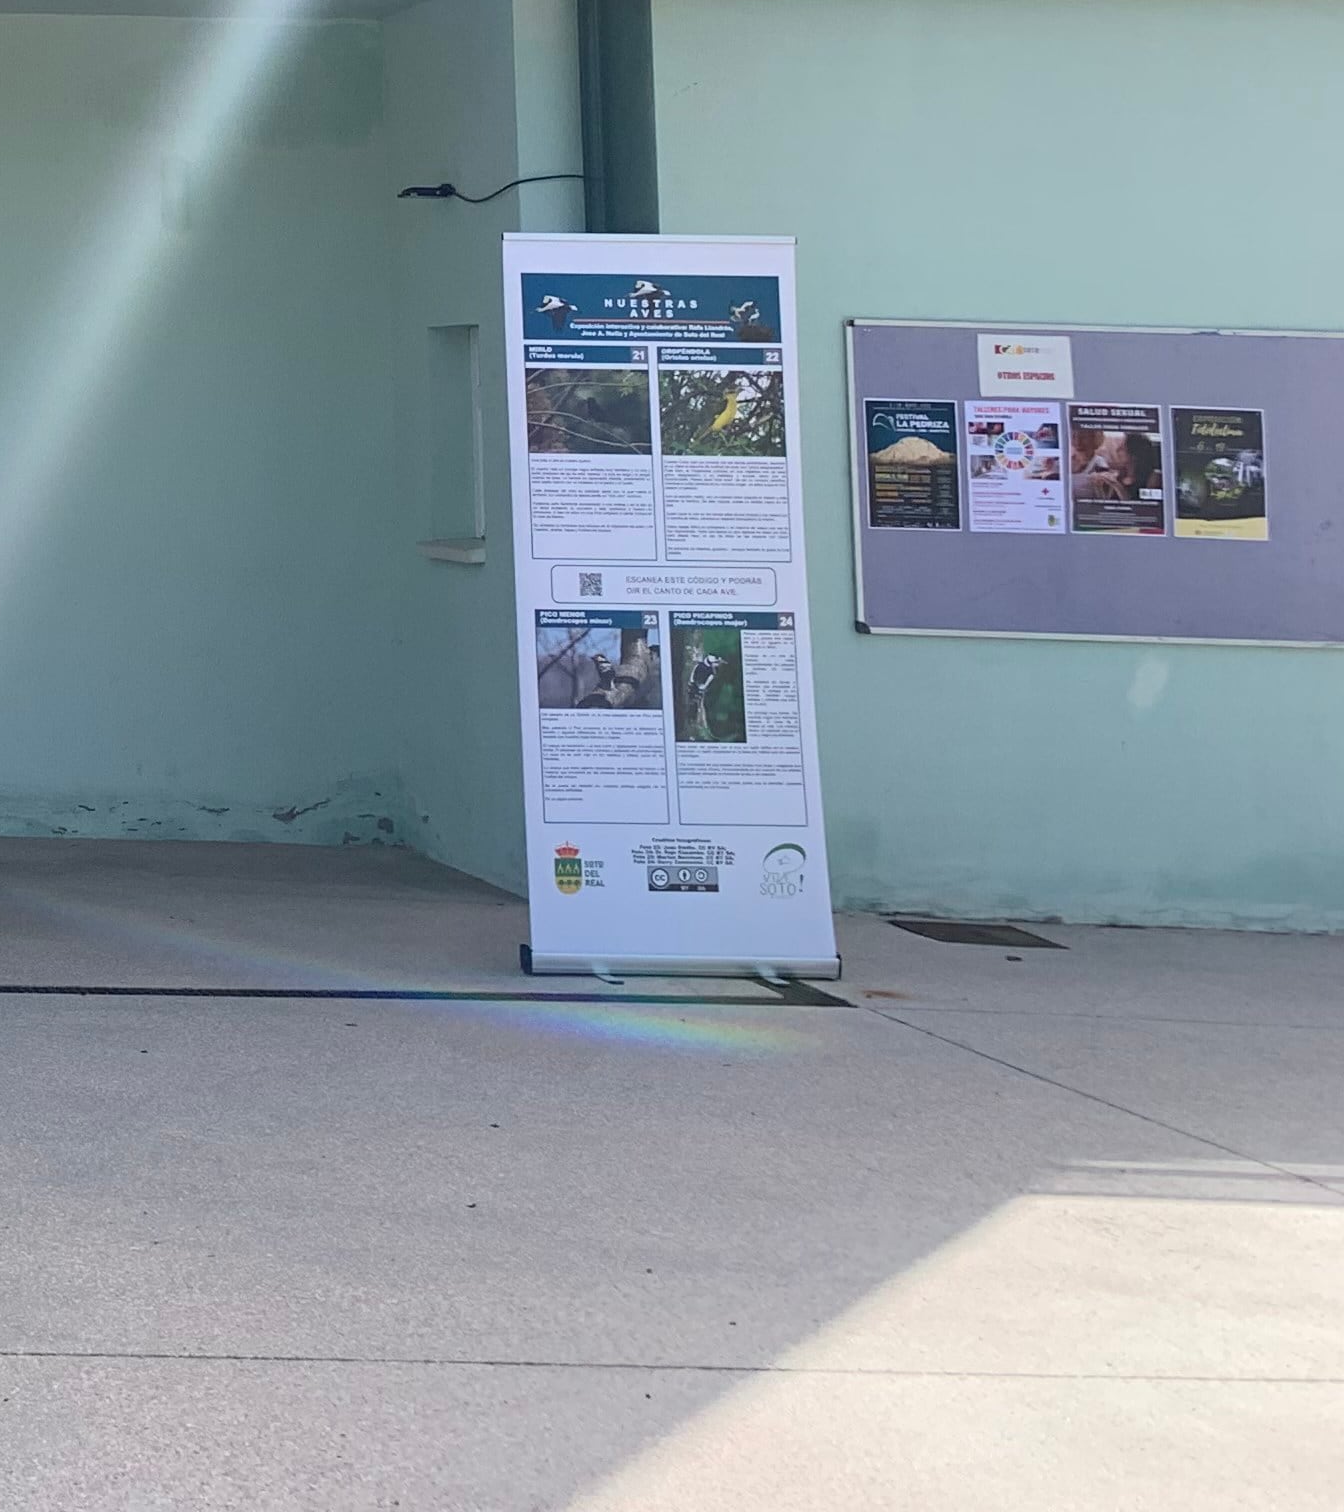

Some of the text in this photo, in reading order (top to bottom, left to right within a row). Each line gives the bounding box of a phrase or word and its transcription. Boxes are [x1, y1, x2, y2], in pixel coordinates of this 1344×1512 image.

[604, 298, 698, 309] NUESTRAS
[629, 309, 674, 319] AVES
[632, 350, 645, 360] 21
[765, 351, 779, 362] 22
[896, 420, 950, 429] LA PEDRIZA
[625, 576, 663, 584] ESCANEA
[664, 576, 685, 584] ESTE
[721, 576, 726, 584] Y
[654, 587, 682, 595] CANTO
[644, 614, 658, 625] 23
[779, 616, 793, 627] 24
[583, 869, 600, 878] DEL
[585, 879, 605, 888] REAL
